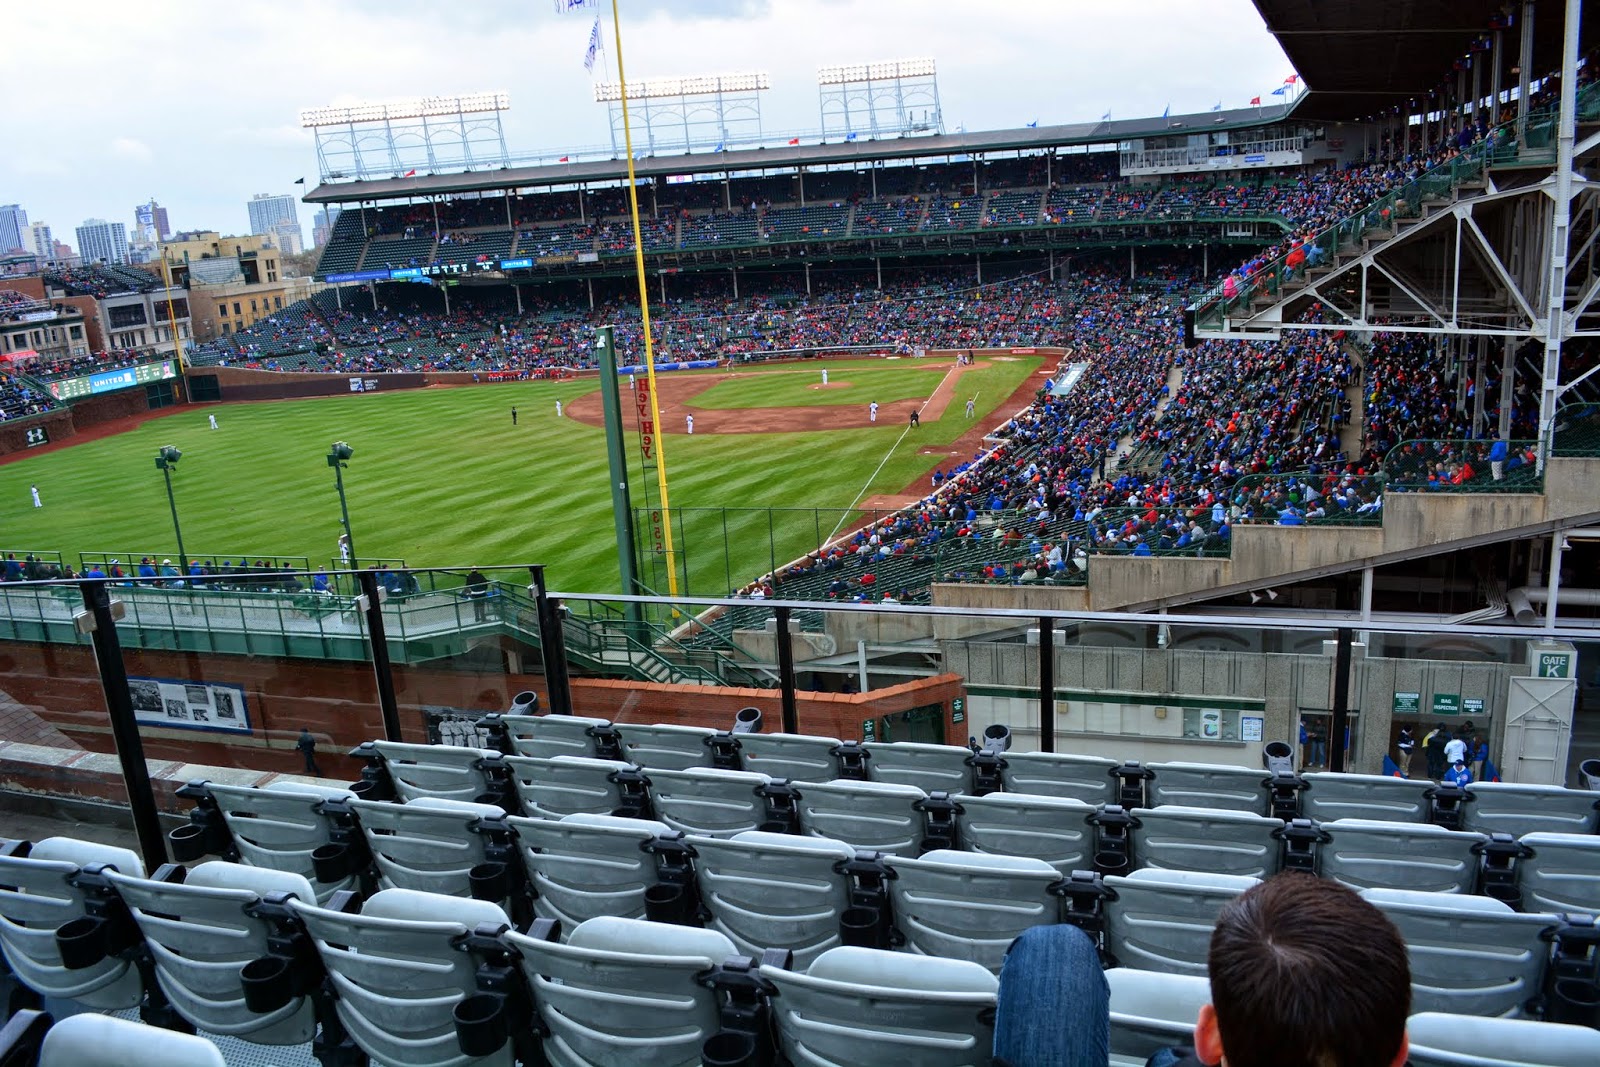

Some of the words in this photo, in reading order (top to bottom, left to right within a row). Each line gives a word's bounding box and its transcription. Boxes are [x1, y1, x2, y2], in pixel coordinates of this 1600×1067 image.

[94, 376, 123, 387] UNITED
[1542, 655, 1566, 665] GATE
[1546, 665, 1560, 677] K
